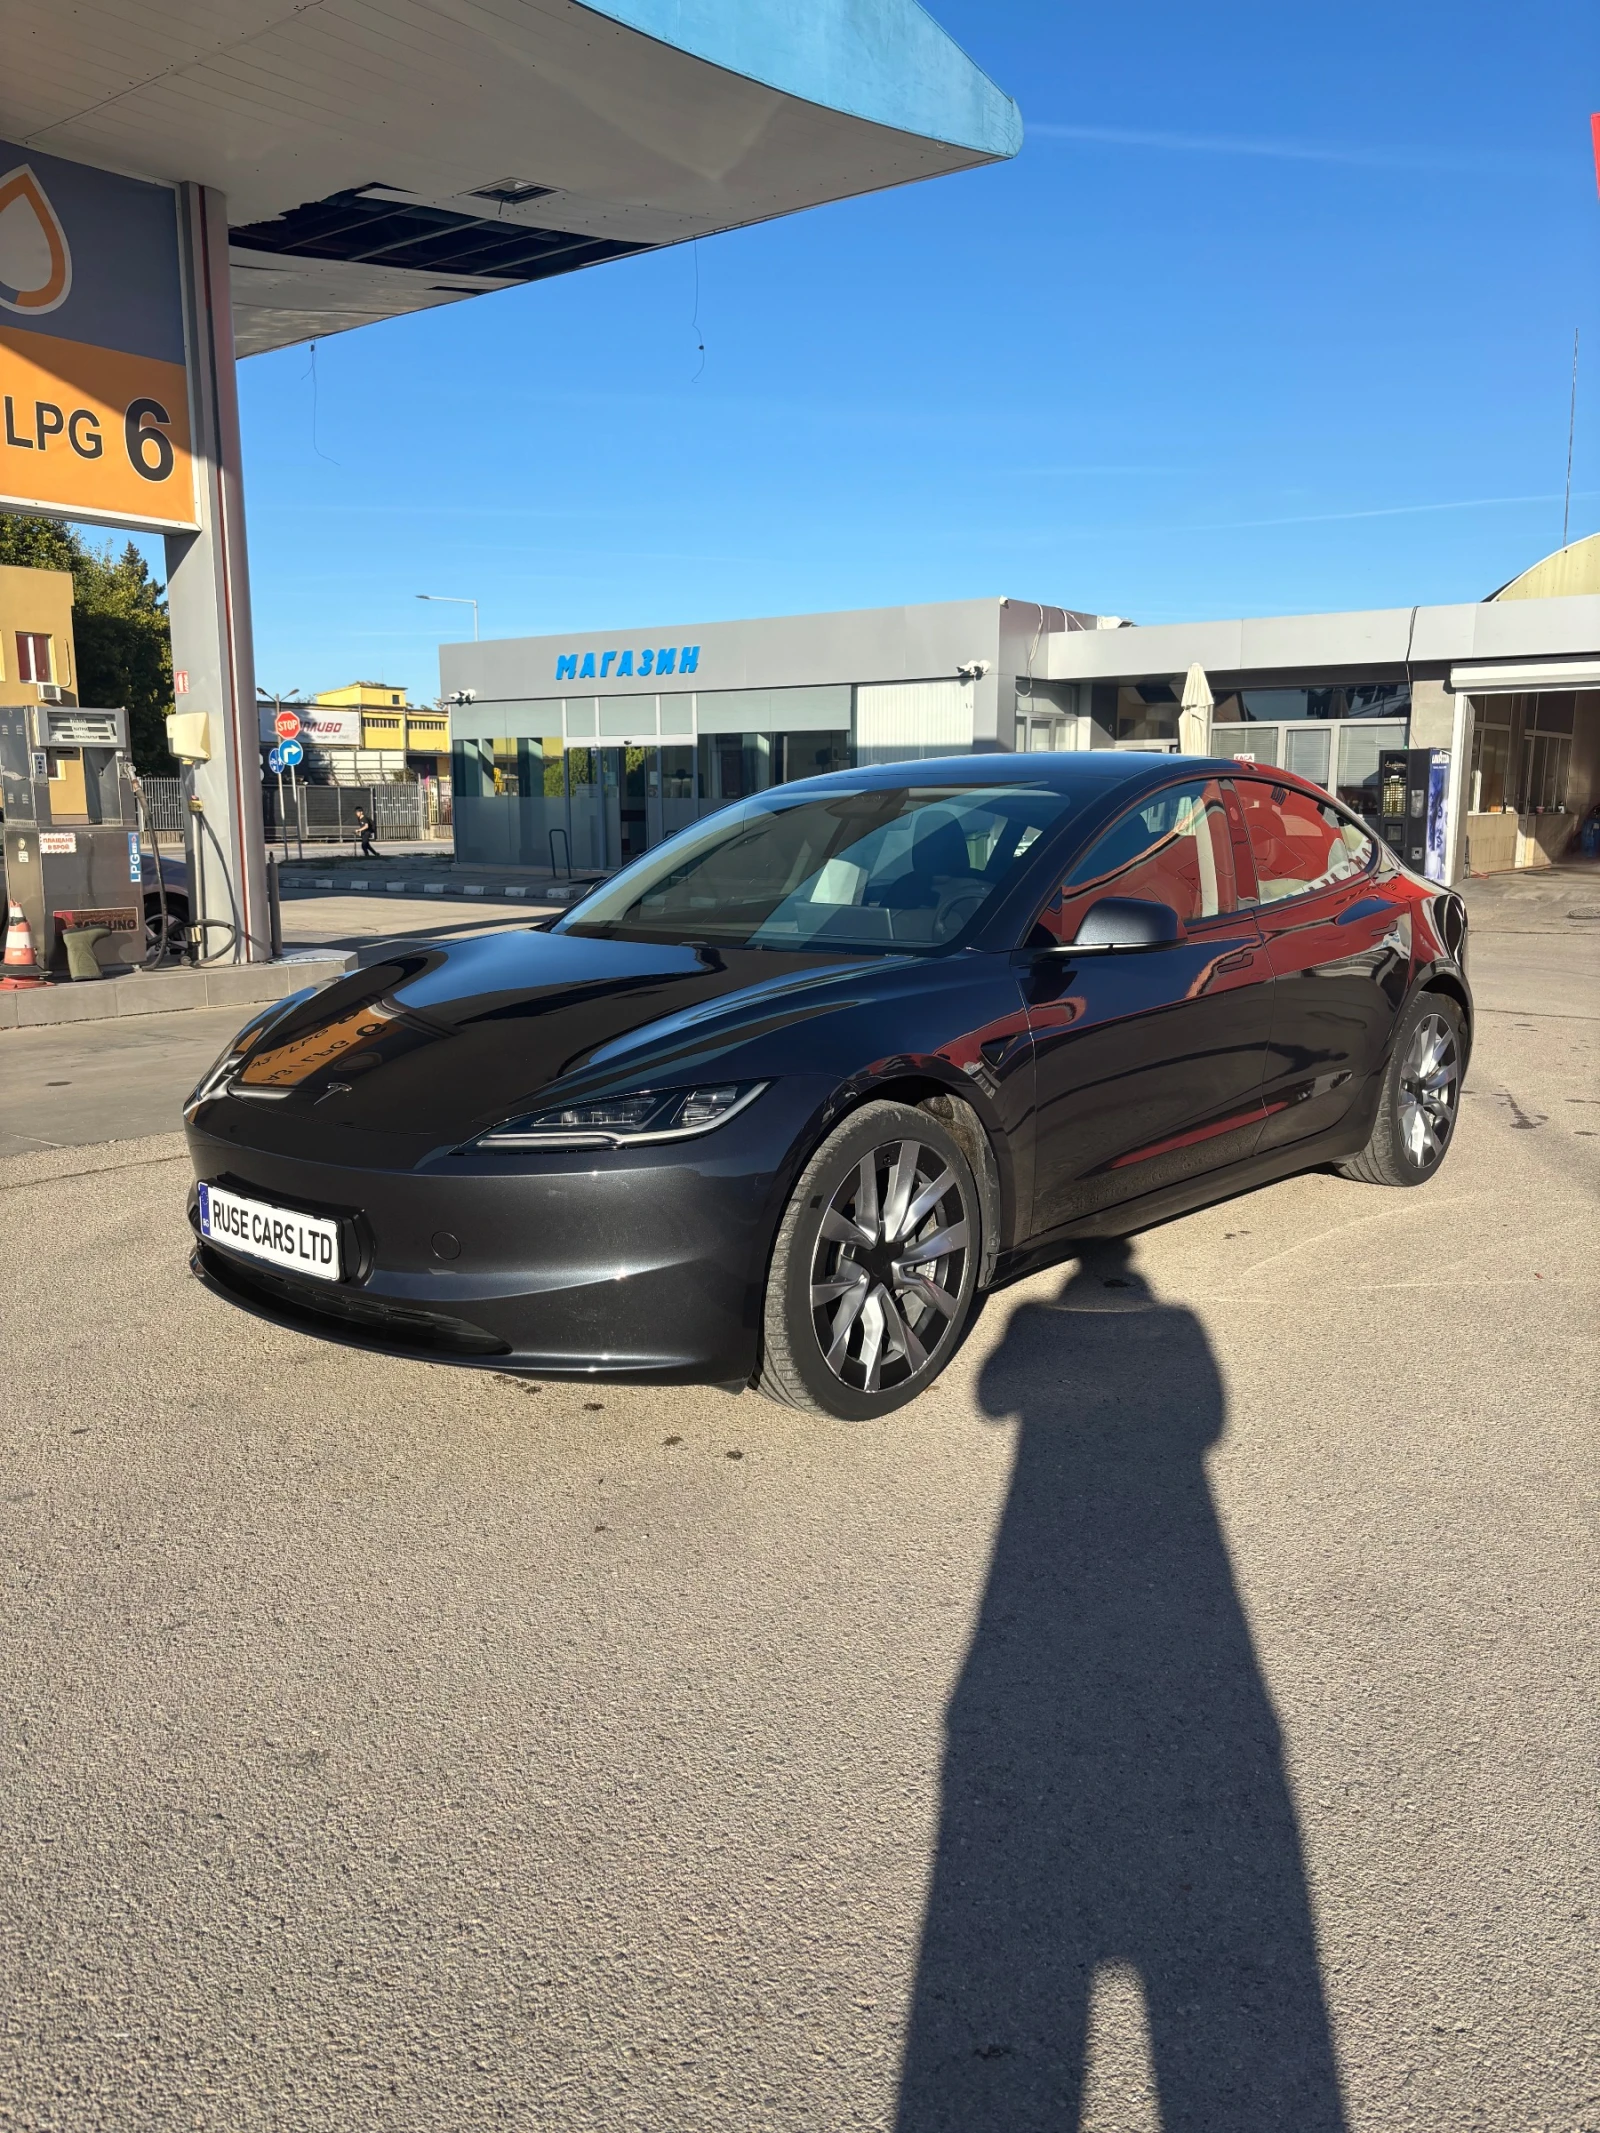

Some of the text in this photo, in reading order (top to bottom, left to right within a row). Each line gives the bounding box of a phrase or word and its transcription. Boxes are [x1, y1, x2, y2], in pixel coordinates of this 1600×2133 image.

[4, 395, 175, 483] LPG 6
[555, 645, 701, 680] МАГАЗИН
[277, 720, 298, 732] STOP
[130, 854, 140, 882] LPG
[202, 1218, 210, 1227] BG
[212, 1199, 332, 1264] RUSE CARS LTD
